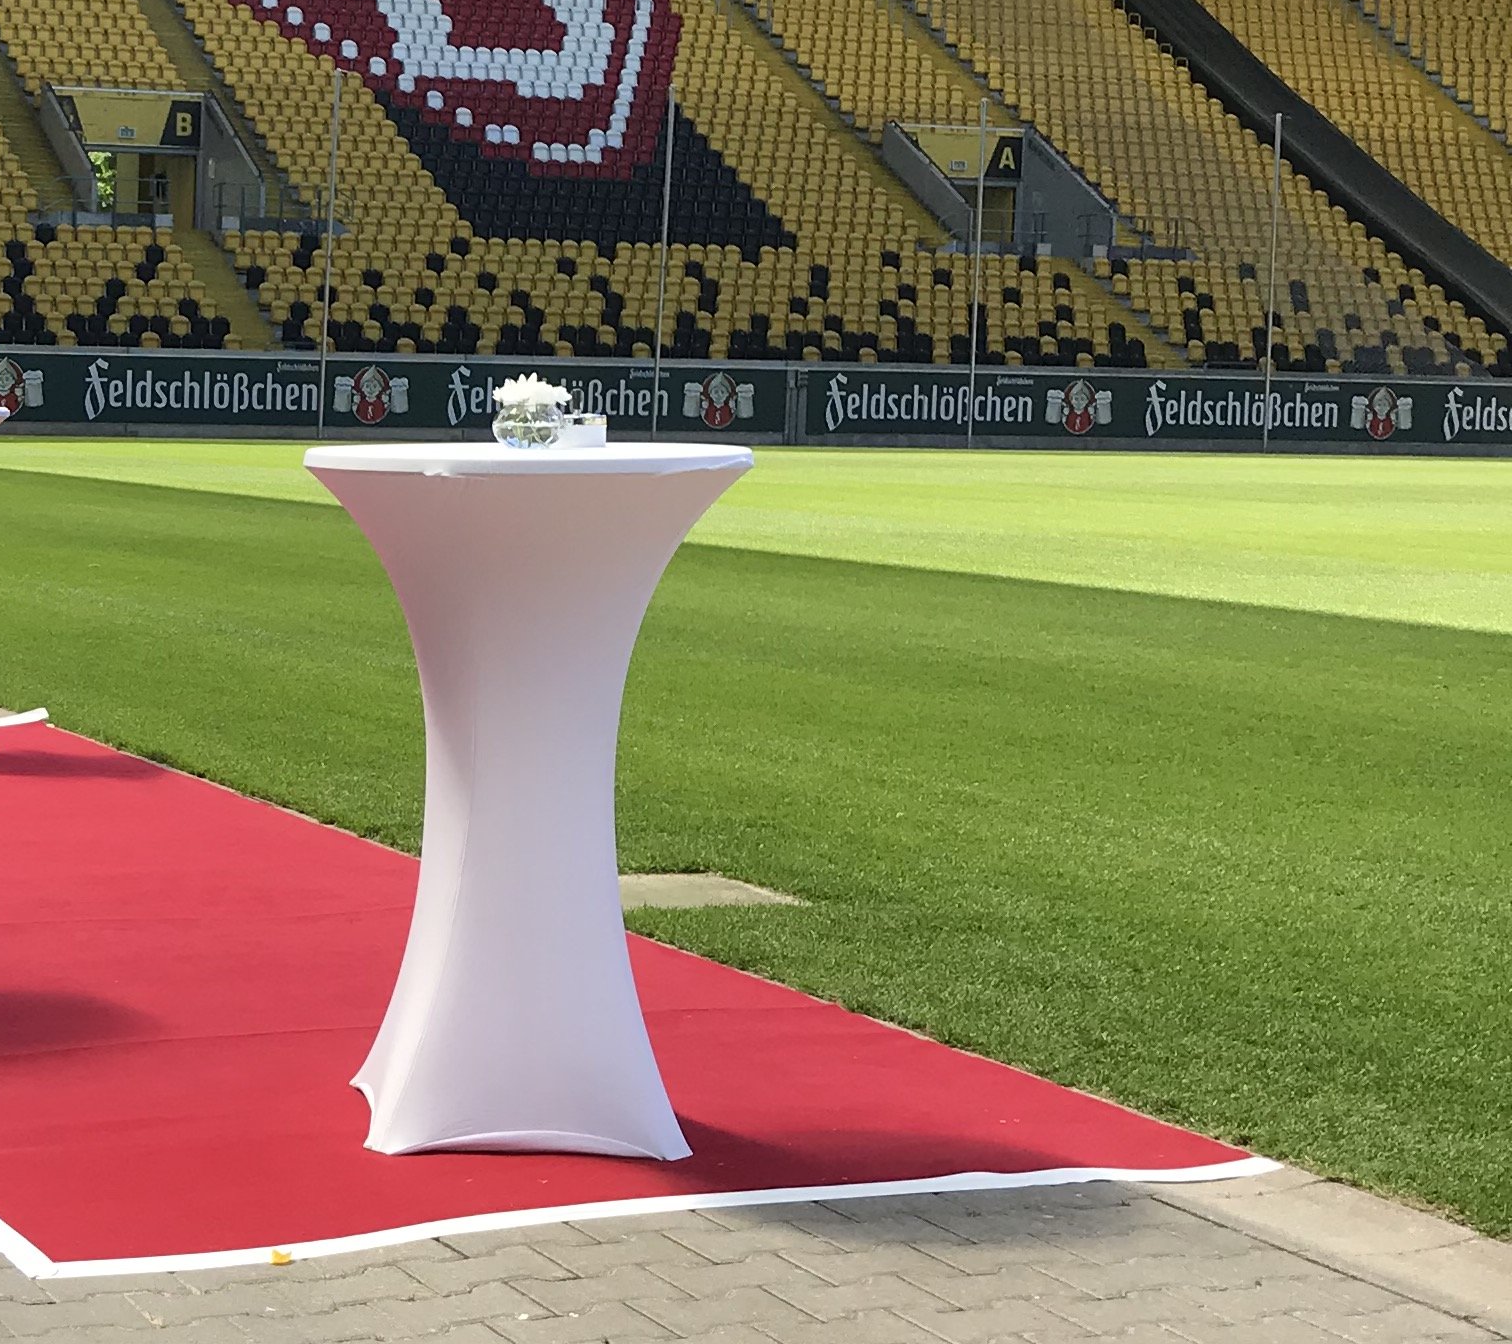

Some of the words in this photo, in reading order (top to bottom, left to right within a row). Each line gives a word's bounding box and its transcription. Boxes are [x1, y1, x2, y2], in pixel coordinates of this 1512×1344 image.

[175, 112, 192, 137] B
[998, 146, 1015, 170] A
[84, 358, 318, 420] Feldschlößchen
[825, 372, 1033, 431] Feldschlößchen
[1144, 380, 1338, 437] Feldschlößchen
[1443, 386, 1512, 441] Felds
